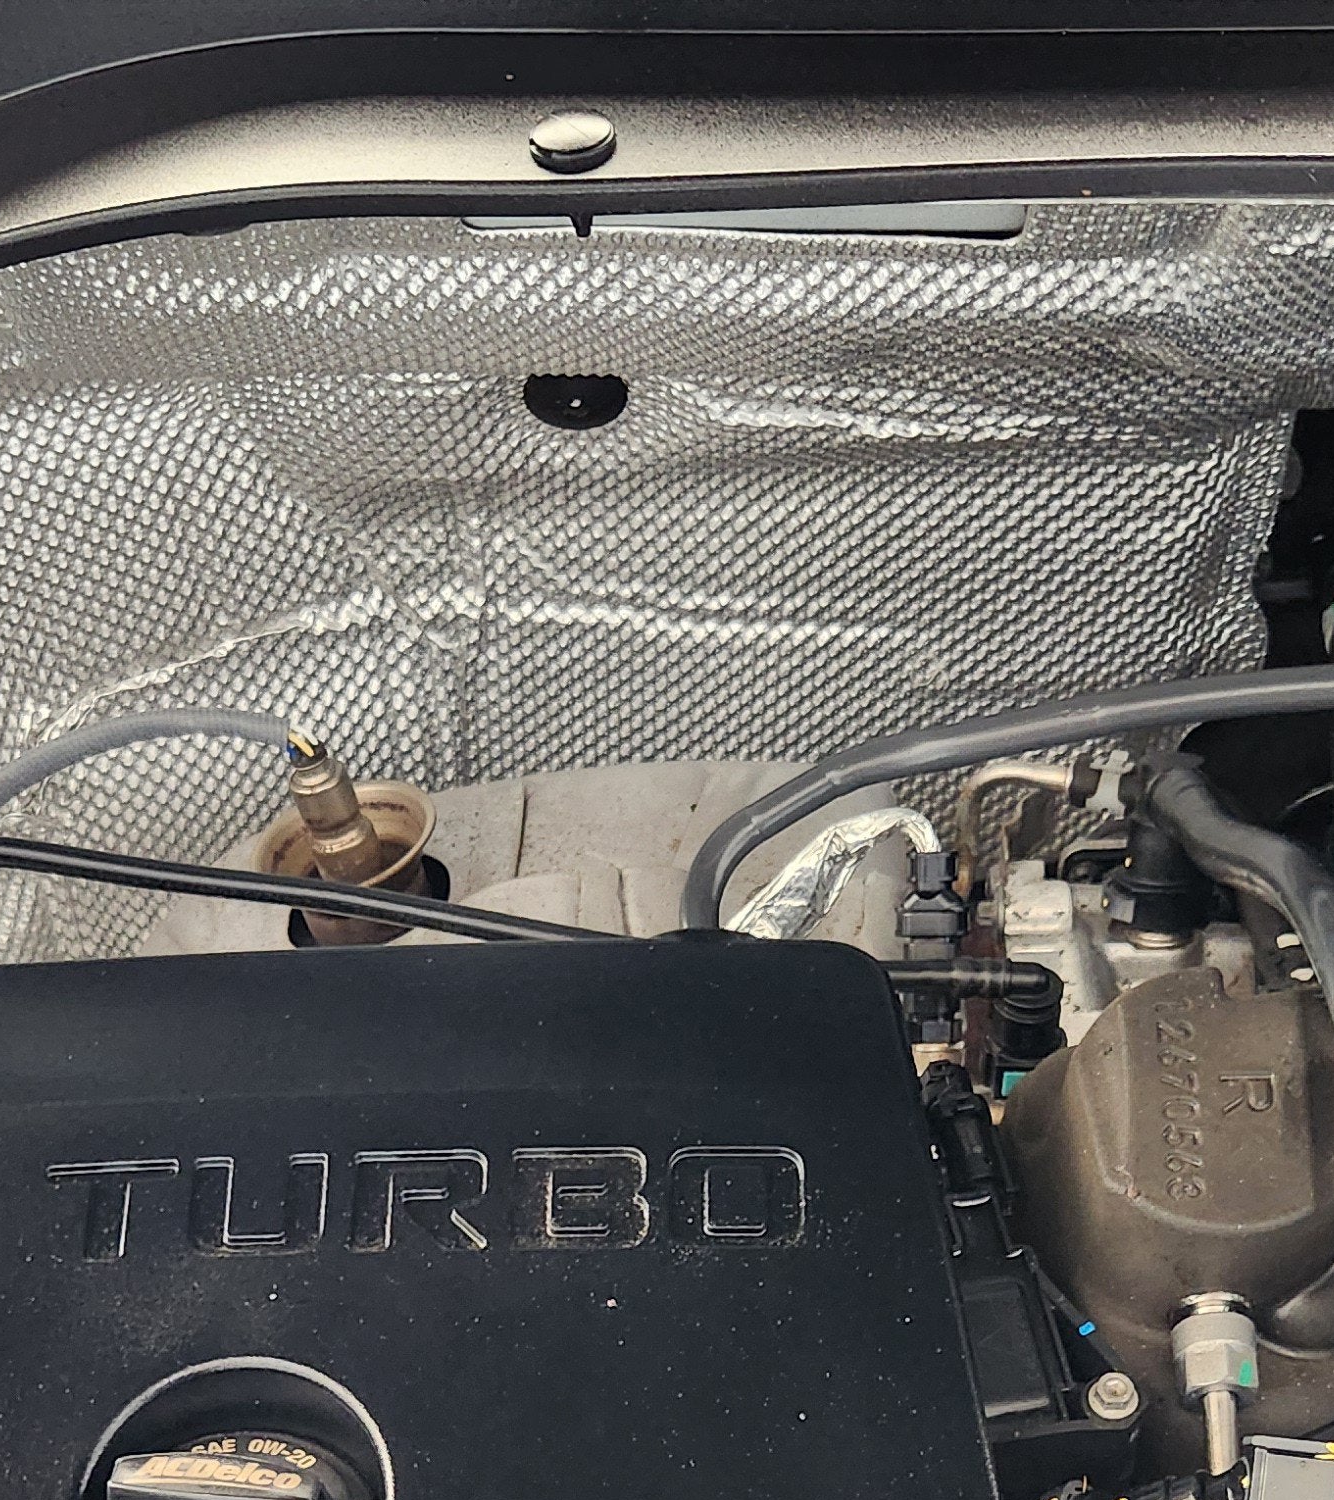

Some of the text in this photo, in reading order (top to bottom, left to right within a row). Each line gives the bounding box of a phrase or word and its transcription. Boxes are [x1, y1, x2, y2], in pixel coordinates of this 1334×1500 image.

[1218, 1070, 1277, 1116] R
[46, 1145, 809, 1263] TURBO
[137, 1456, 303, 1490] ACDelco
[248, 1438, 317, 1470] 0W-20
